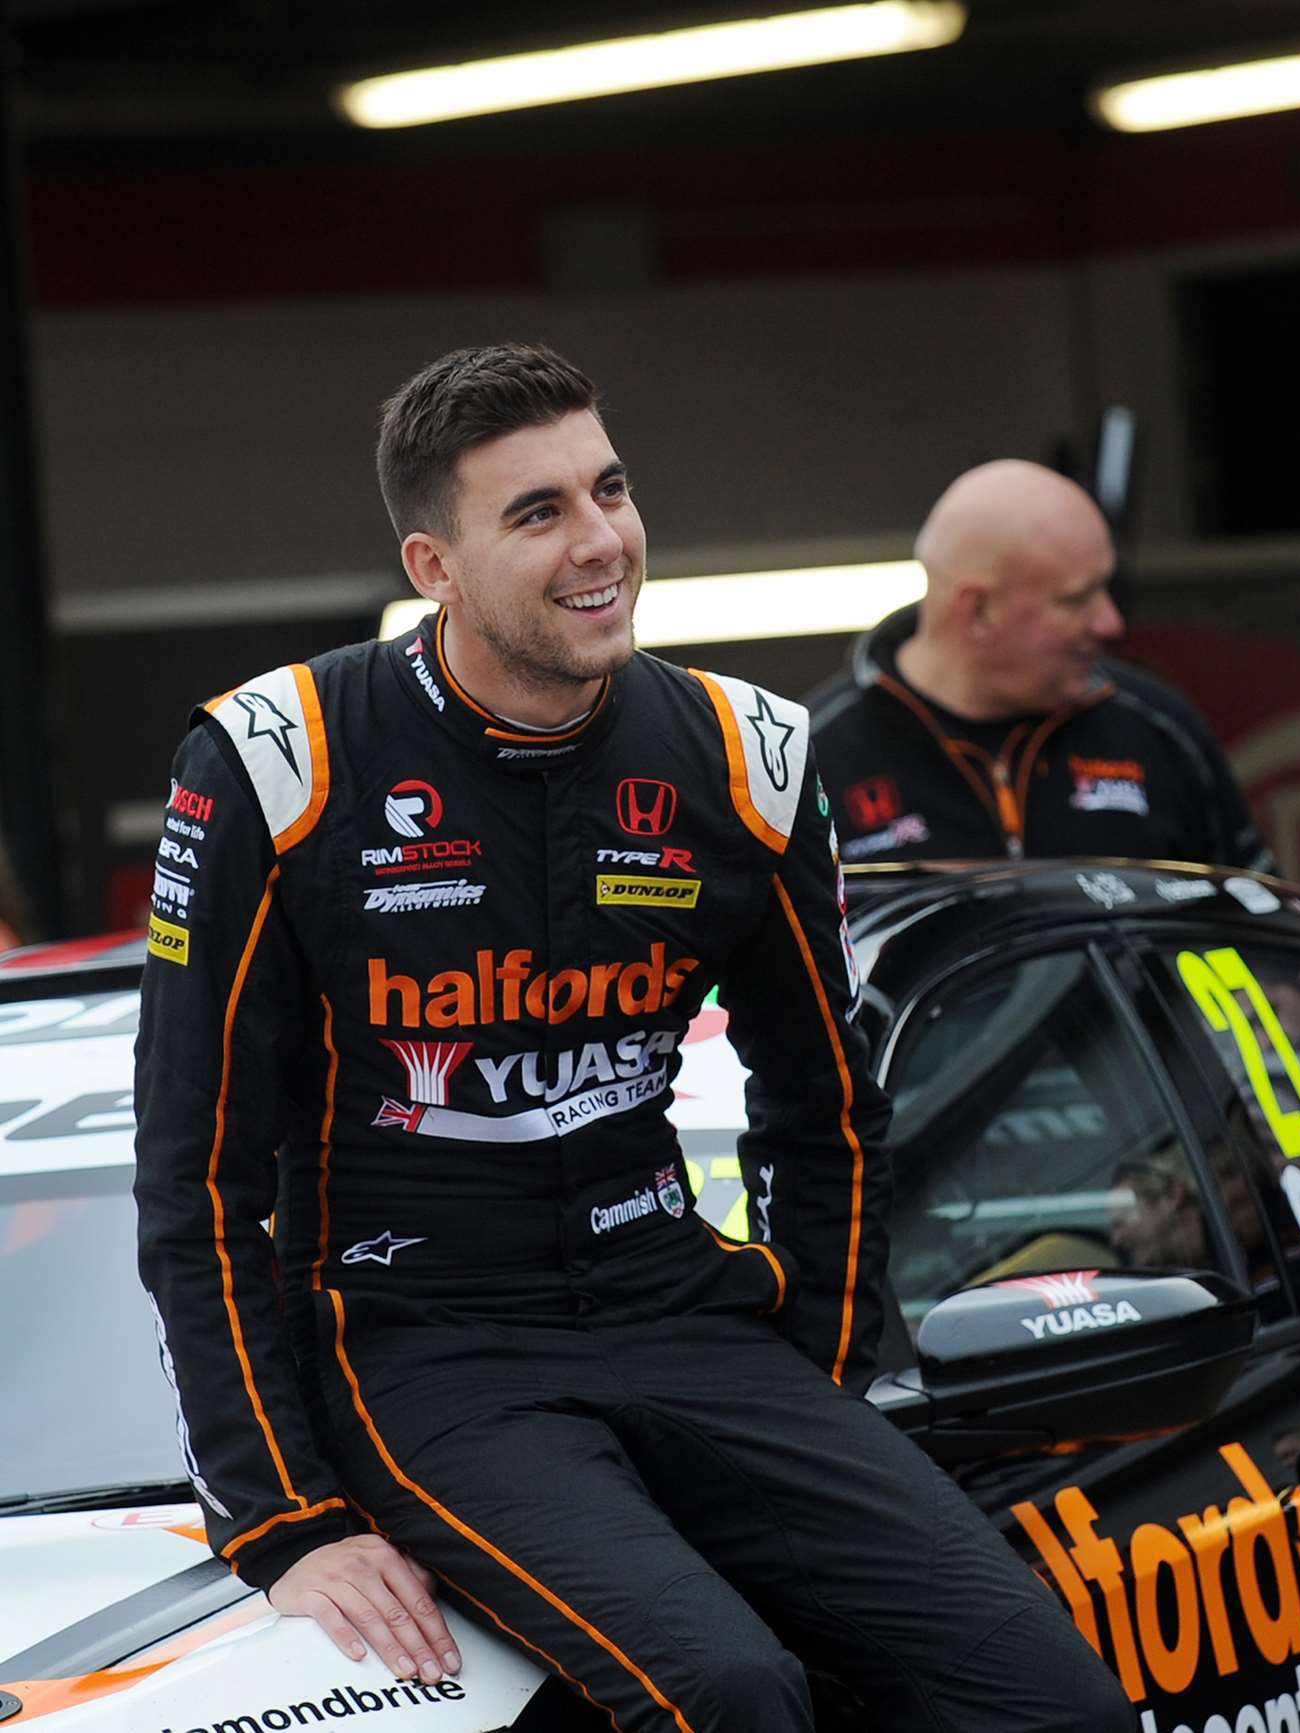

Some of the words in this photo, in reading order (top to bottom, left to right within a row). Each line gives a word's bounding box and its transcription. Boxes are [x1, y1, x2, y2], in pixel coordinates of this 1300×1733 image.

[410, 656, 446, 713] YUASA
[361, 839, 483, 866] RIMSTOCK
[596, 849, 661, 866] TYPE
[658, 847, 697, 873] R
[612, 884, 694, 899] DUNLOP
[367, 942, 700, 1029] halfords
[474, 1030, 681, 1103] YUASA
[551, 1090, 619, 1129] RACING
[590, 1186, 659, 1235] Cammish
[1021, 1300, 1142, 1340] YUASA
[162, 1677, 467, 1733] mondbrite
